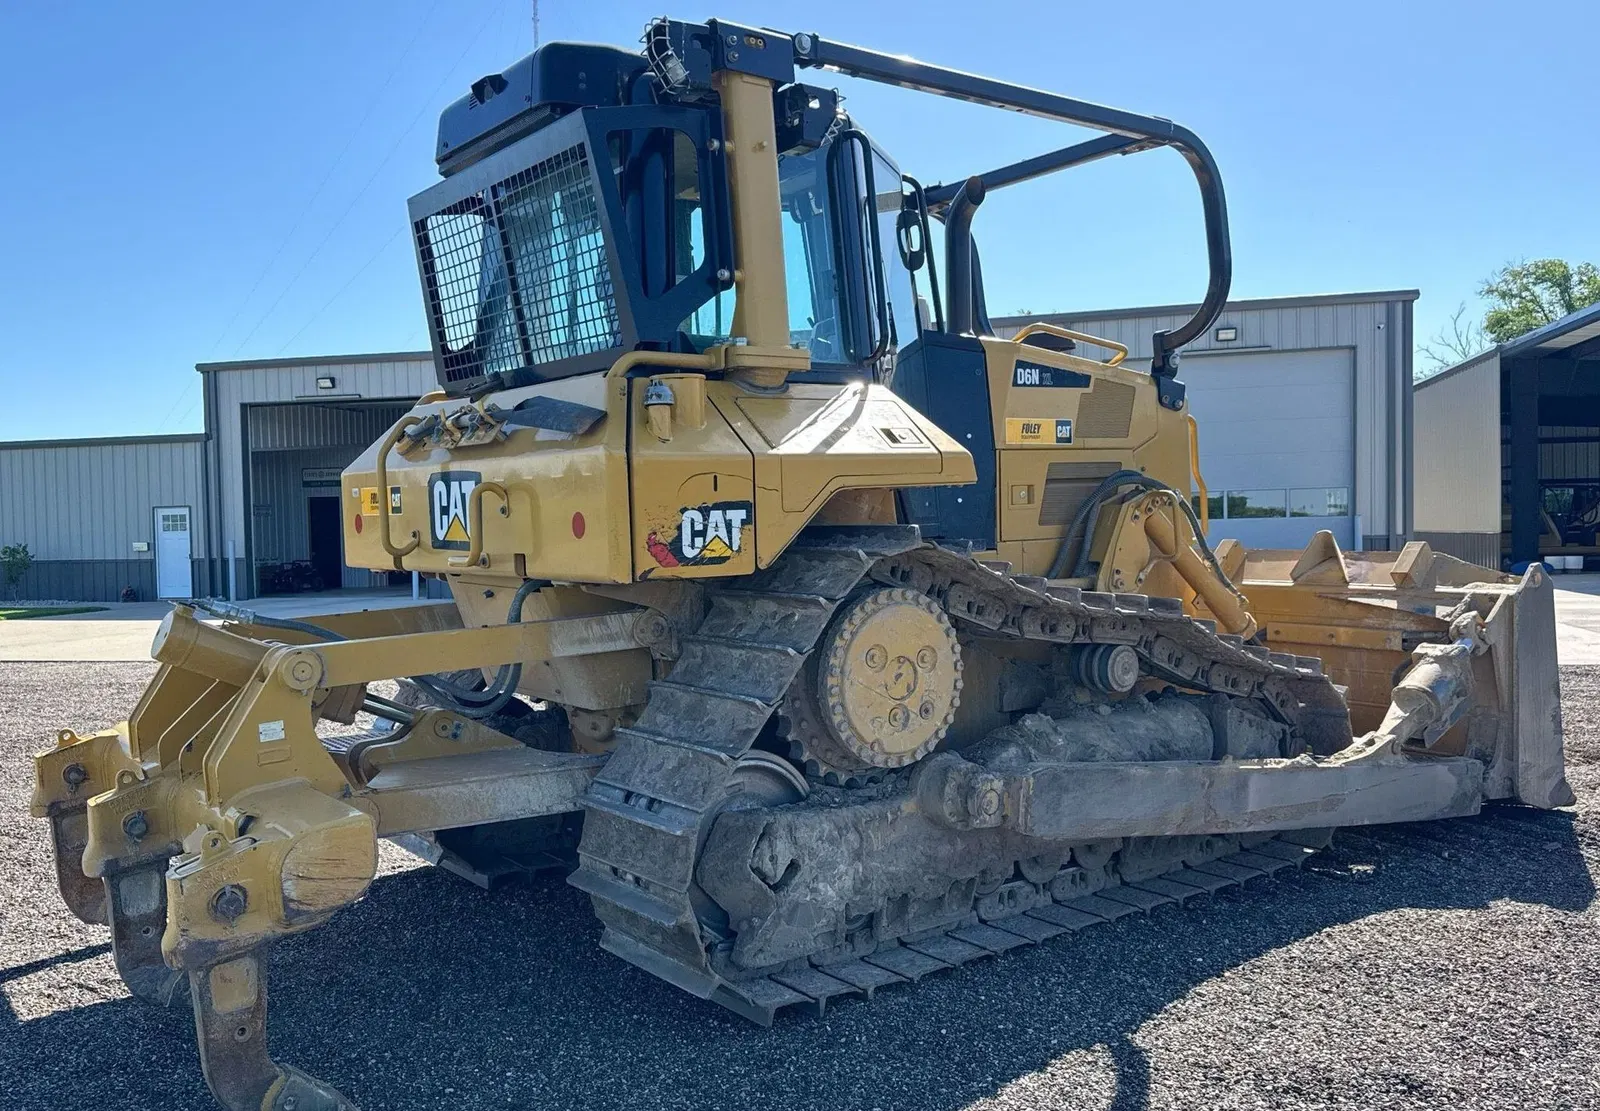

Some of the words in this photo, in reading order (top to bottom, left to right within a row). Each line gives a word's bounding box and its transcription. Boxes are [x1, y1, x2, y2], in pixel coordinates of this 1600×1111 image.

[1017, 368, 1039, 385] D6N
[1021, 423, 1041, 434] FOLEY
[1057, 425, 1071, 438] CAT
[433, 480, 475, 541] CAT
[681, 509, 747, 559] CAT
